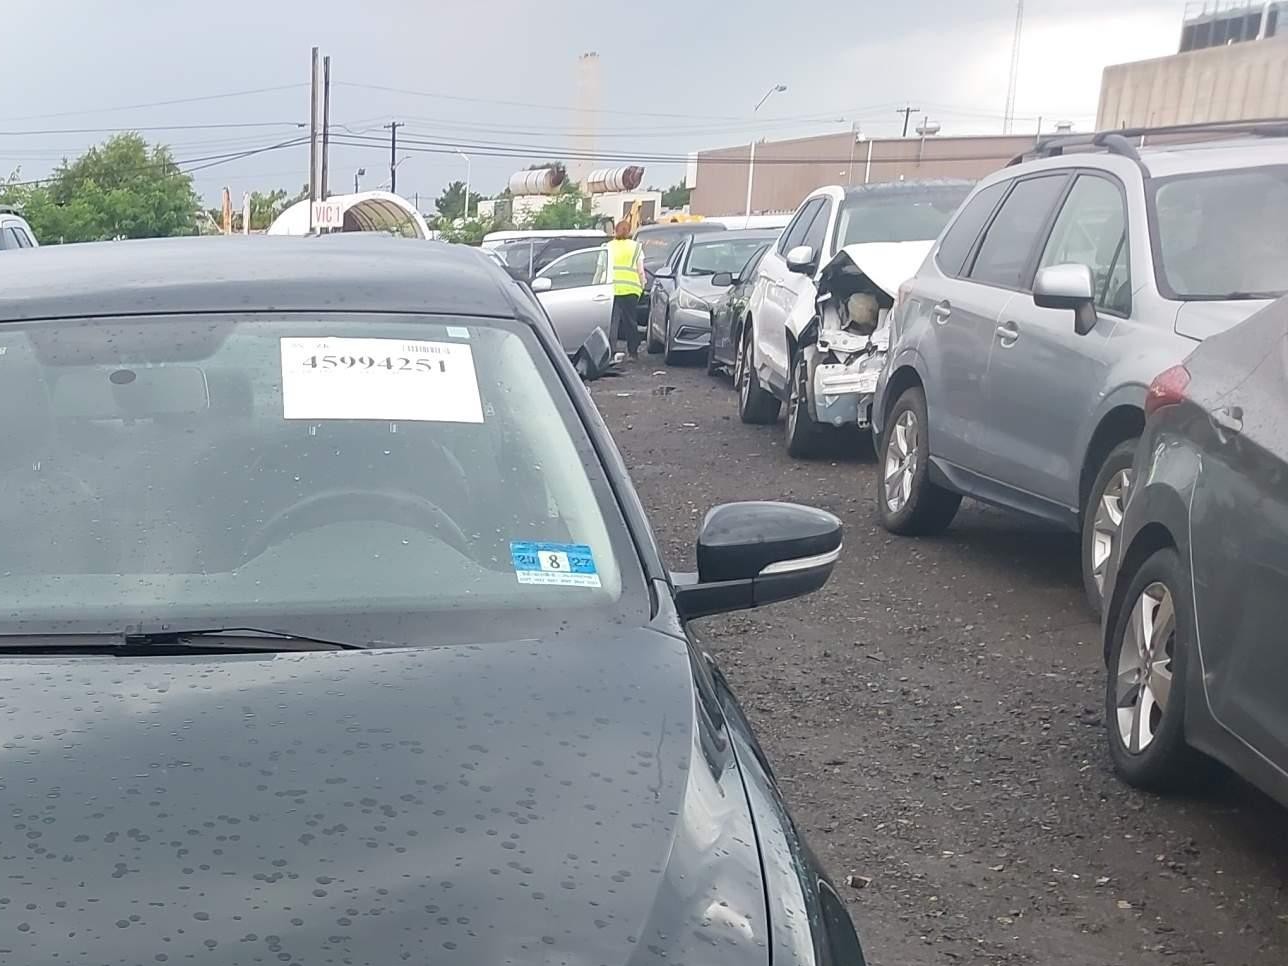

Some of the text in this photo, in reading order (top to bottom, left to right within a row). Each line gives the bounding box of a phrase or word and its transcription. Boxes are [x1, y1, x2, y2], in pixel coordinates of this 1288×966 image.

[315, 206, 332, 223] VIC
[302, 355, 447, 373] 45994251
[548, 554, 561, 569] 8
